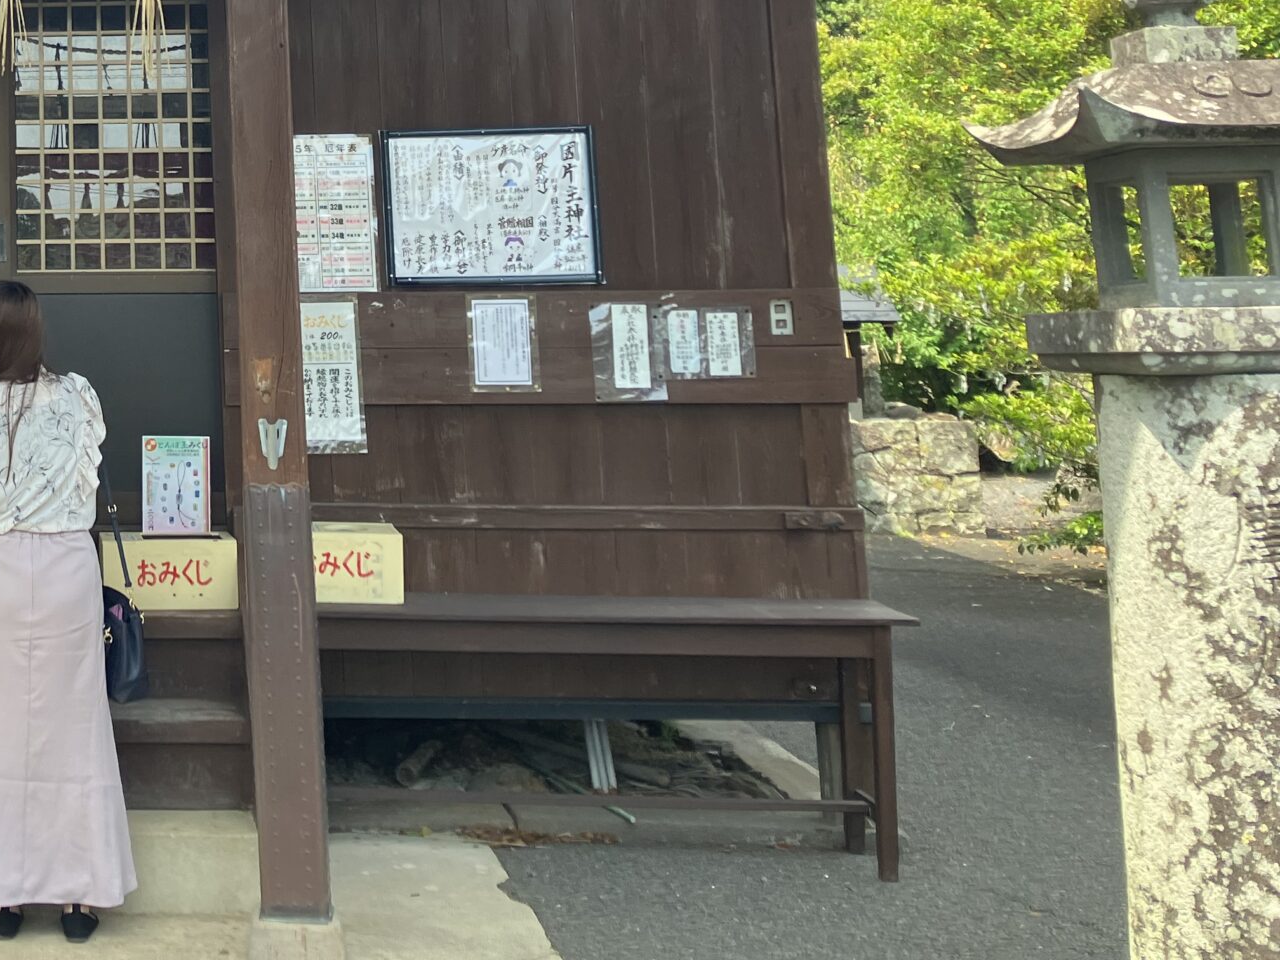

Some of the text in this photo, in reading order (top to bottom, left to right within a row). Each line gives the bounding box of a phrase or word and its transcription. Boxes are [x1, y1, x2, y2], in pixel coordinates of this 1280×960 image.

[303, 314, 347, 328] おみくじ
[136, 558, 213, 587] おみくじ
[314, 550, 374, 578] みくじ
